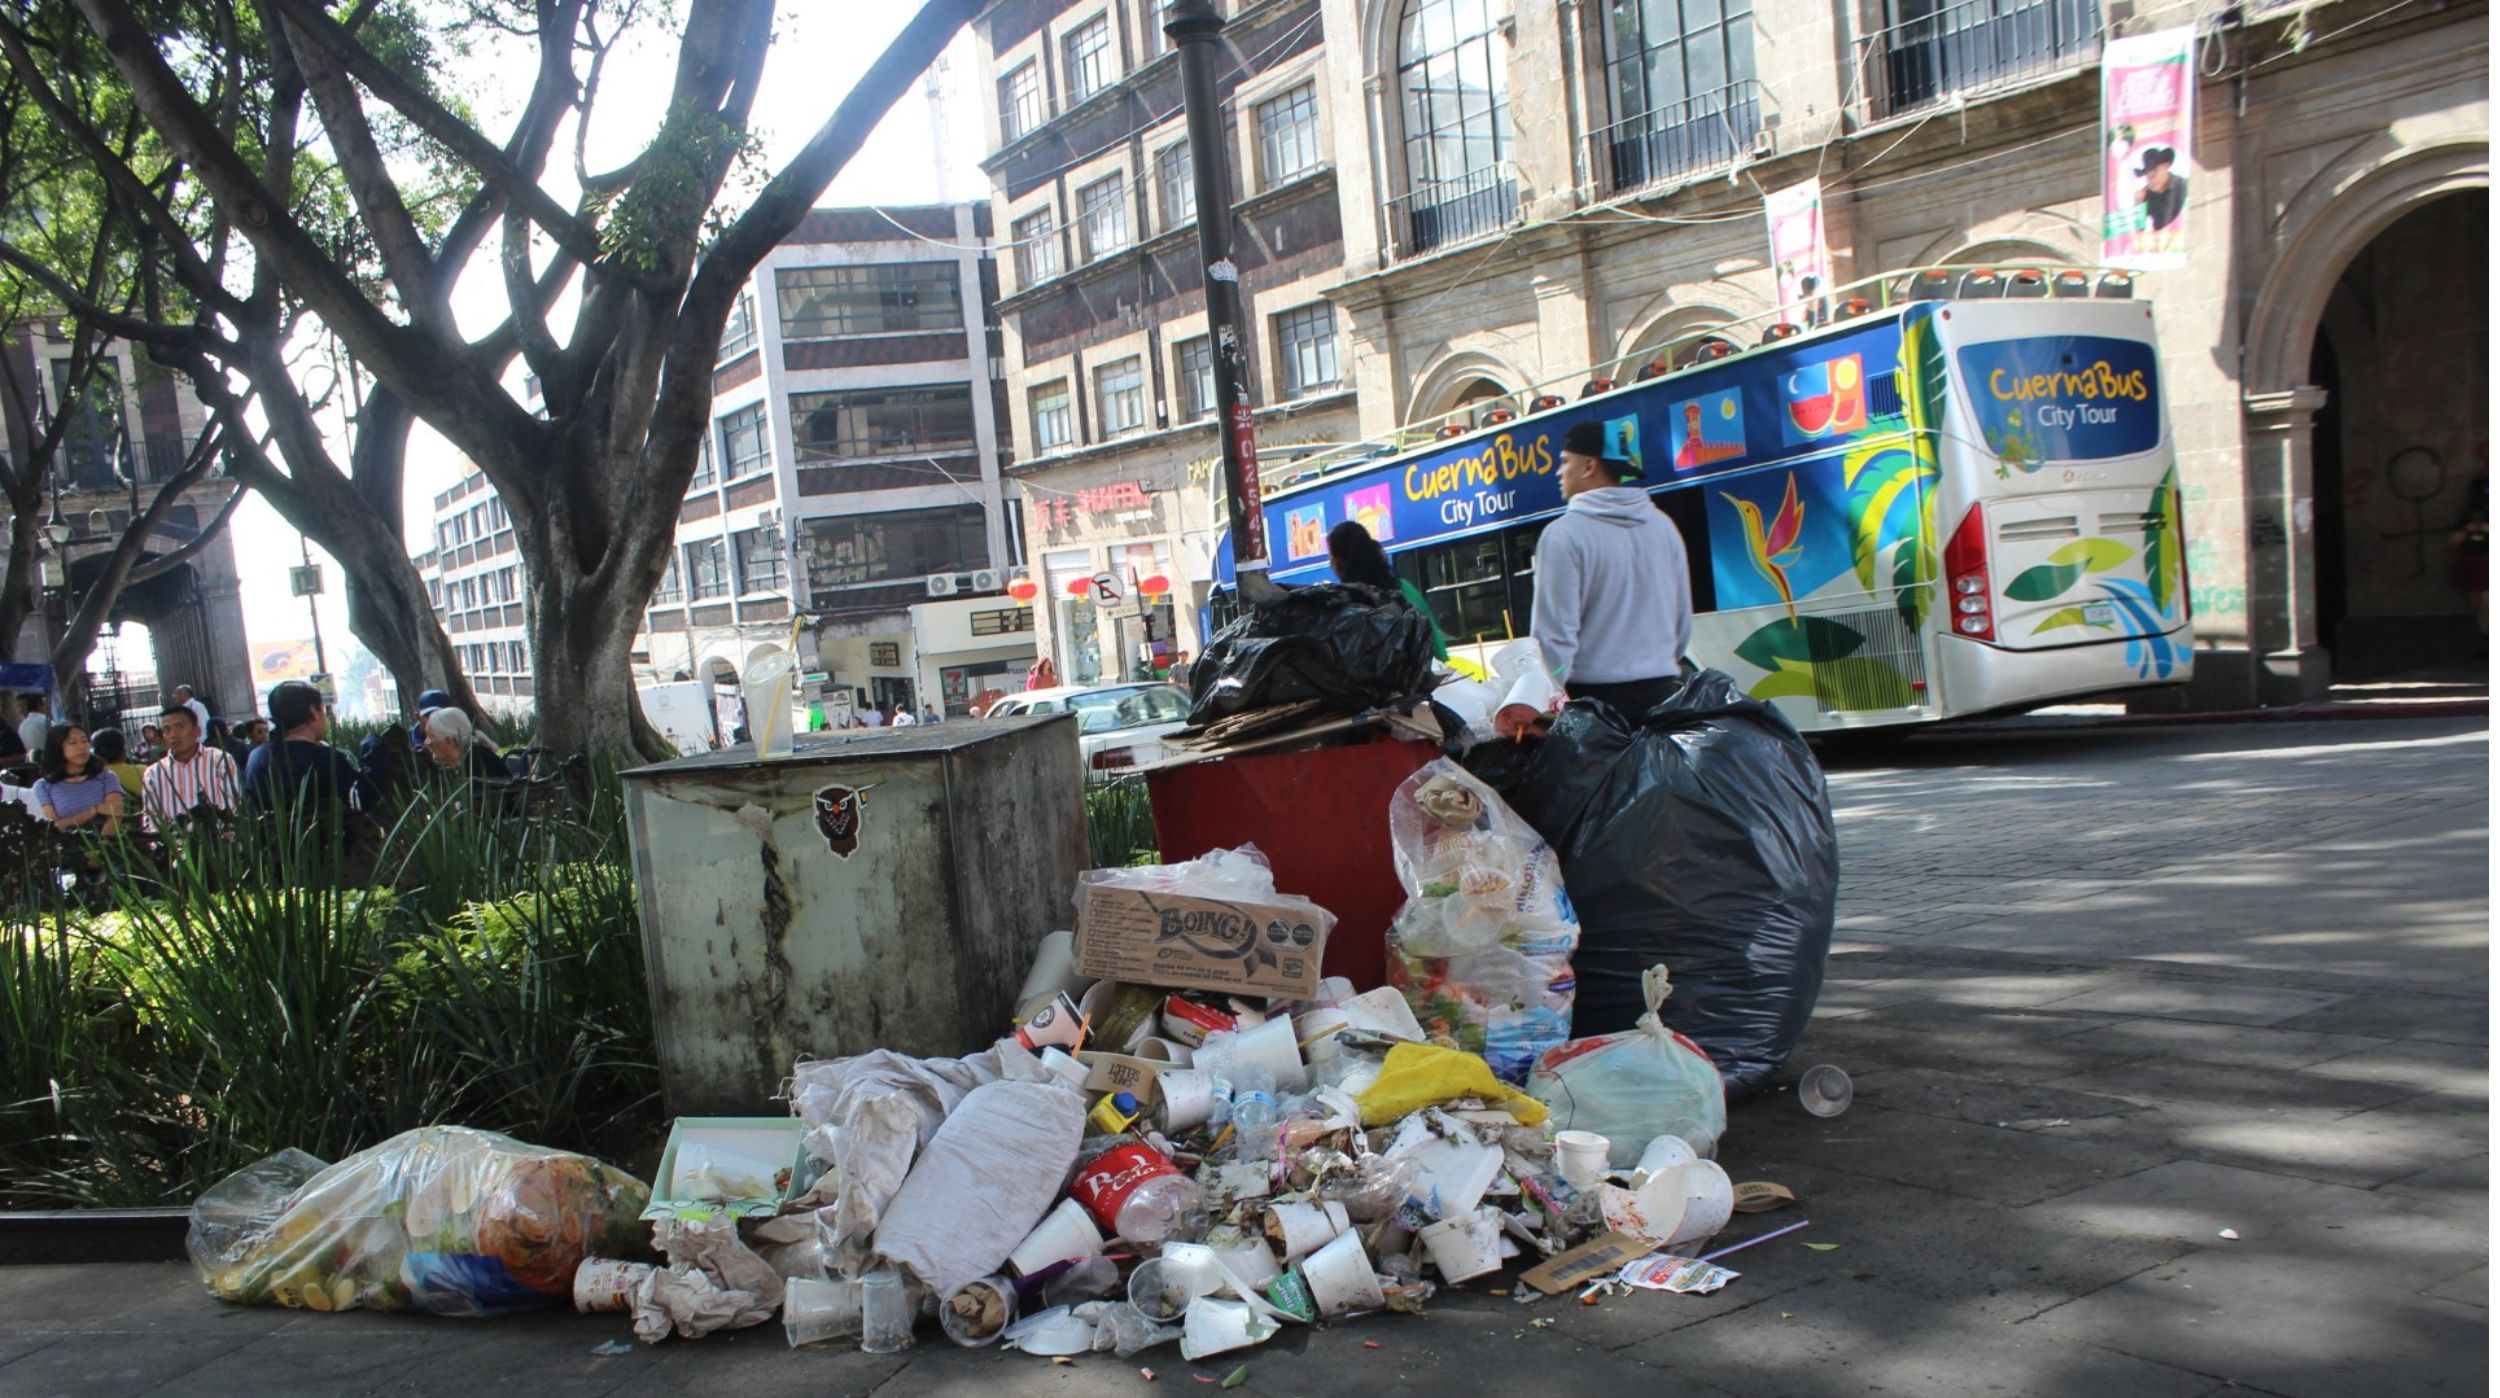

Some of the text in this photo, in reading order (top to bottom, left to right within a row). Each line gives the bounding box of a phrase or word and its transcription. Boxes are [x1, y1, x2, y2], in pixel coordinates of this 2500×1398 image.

[1989, 360, 2148, 401] CuernaBus
[2038, 403, 2117, 431] City Tour
[1405, 433, 1553, 502] CuernaBus
[1441, 489, 1516, 527] City Tour
